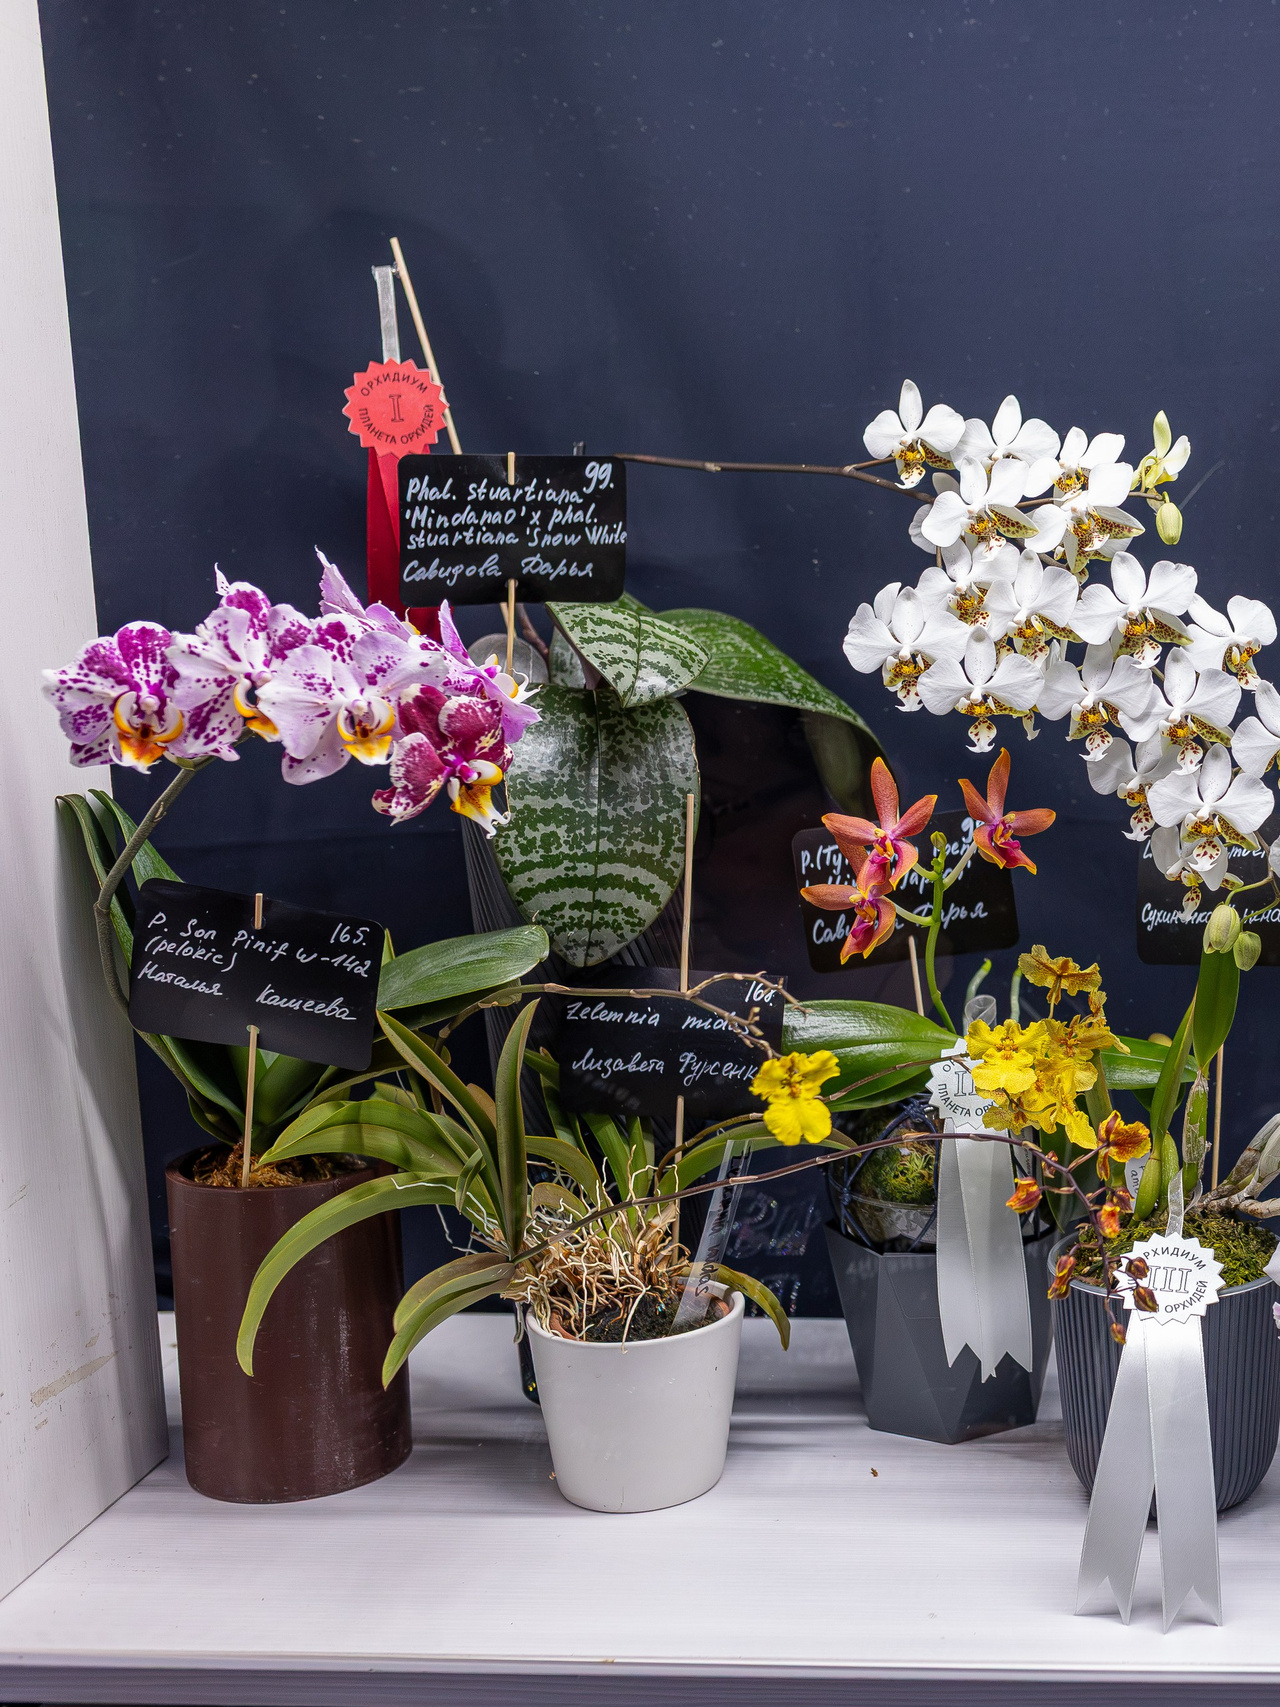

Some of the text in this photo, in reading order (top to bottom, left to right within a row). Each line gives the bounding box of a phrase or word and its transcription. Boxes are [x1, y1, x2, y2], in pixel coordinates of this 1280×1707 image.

[360, 372, 428, 397] ОРХИДИУМ
[359, 404, 434, 445] ПЛАНЕТА ОРХИДЕЙ
[389, 394, 404, 423] I
[406, 461, 615, 505] Phal. stuartiana 99.
[531, 510, 541, 525] x
[548, 502, 598, 531] phal.
[407, 527, 519, 550] stuartiana
[402, 553, 594, 586] Савидова Дарья
[147, 912, 168, 932] P.
[179, 918, 217, 940] Son
[329, 923, 371, 947] 165.
[912, 901, 988, 931] Дрья
[137, 961, 223, 996] Наталья
[571, 1047, 759, 1087] Лизавета Фурсенк
[938, 1083, 971, 1117] ПЛАНЕТА
[1143, 1246, 1206, 1270] РХИДИУМ
[1164, 1280, 1208, 1313] ОРХИДЕЙ
